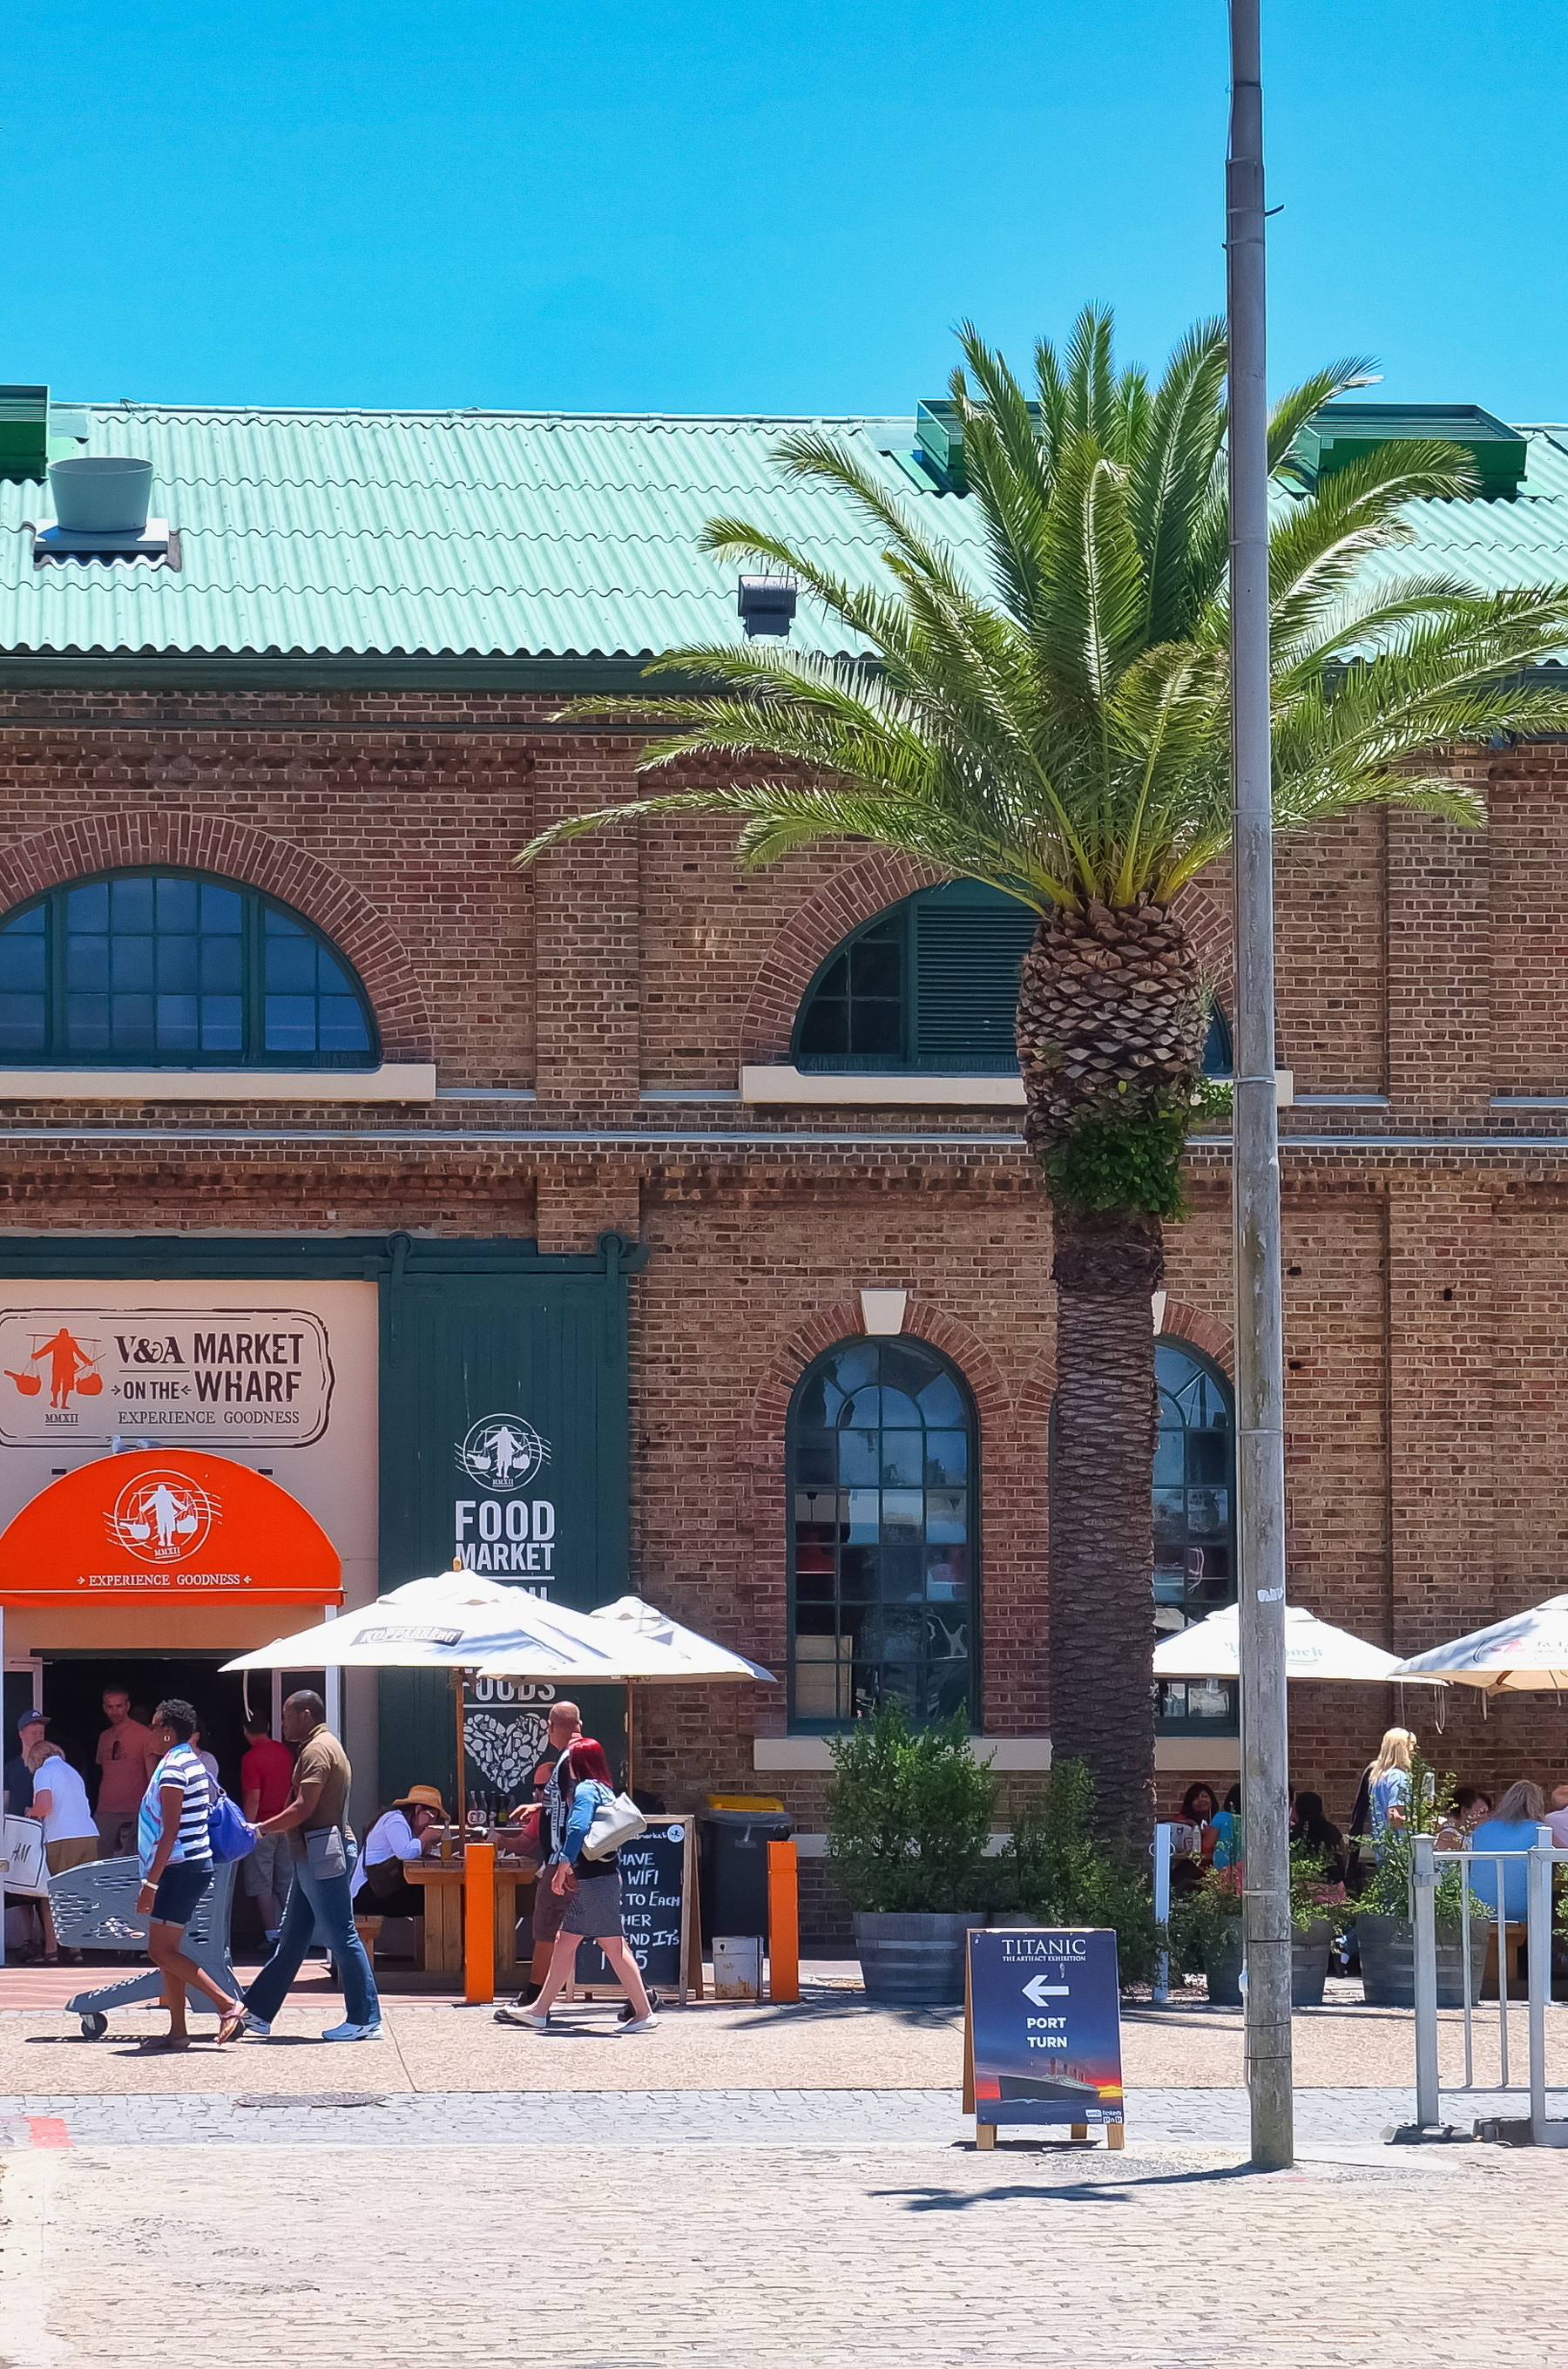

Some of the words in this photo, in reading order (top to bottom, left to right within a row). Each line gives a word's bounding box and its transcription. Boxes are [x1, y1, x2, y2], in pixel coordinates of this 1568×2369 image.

[113, 1335, 186, 1364] V&A
[193, 1333, 304, 1364] MARKET
[123, 1381, 147, 1399] ON
[150, 1381, 180, 1399] THE
[194, 1371, 302, 1402] WHARF
[44, 1413, 79, 1424] MMXII
[118, 1411, 216, 1425] EXPERIENCE
[224, 1411, 300, 1425] GOODNESS
[455, 1500, 555, 1541] FOOD
[455, 1542, 555, 1571] MARKET
[88, 1574, 171, 1587] EXPERIENCE
[176, 1574, 240, 1586] GOODNESS
[627, 1870, 659, 1885] WIFI
[625, 1893, 645, 1905] TO
[1002, 1939, 1085, 1954] TITANIC
[1026, 2017, 1066, 2029] PORT
[1027, 2036, 1067, 2047] TURN
